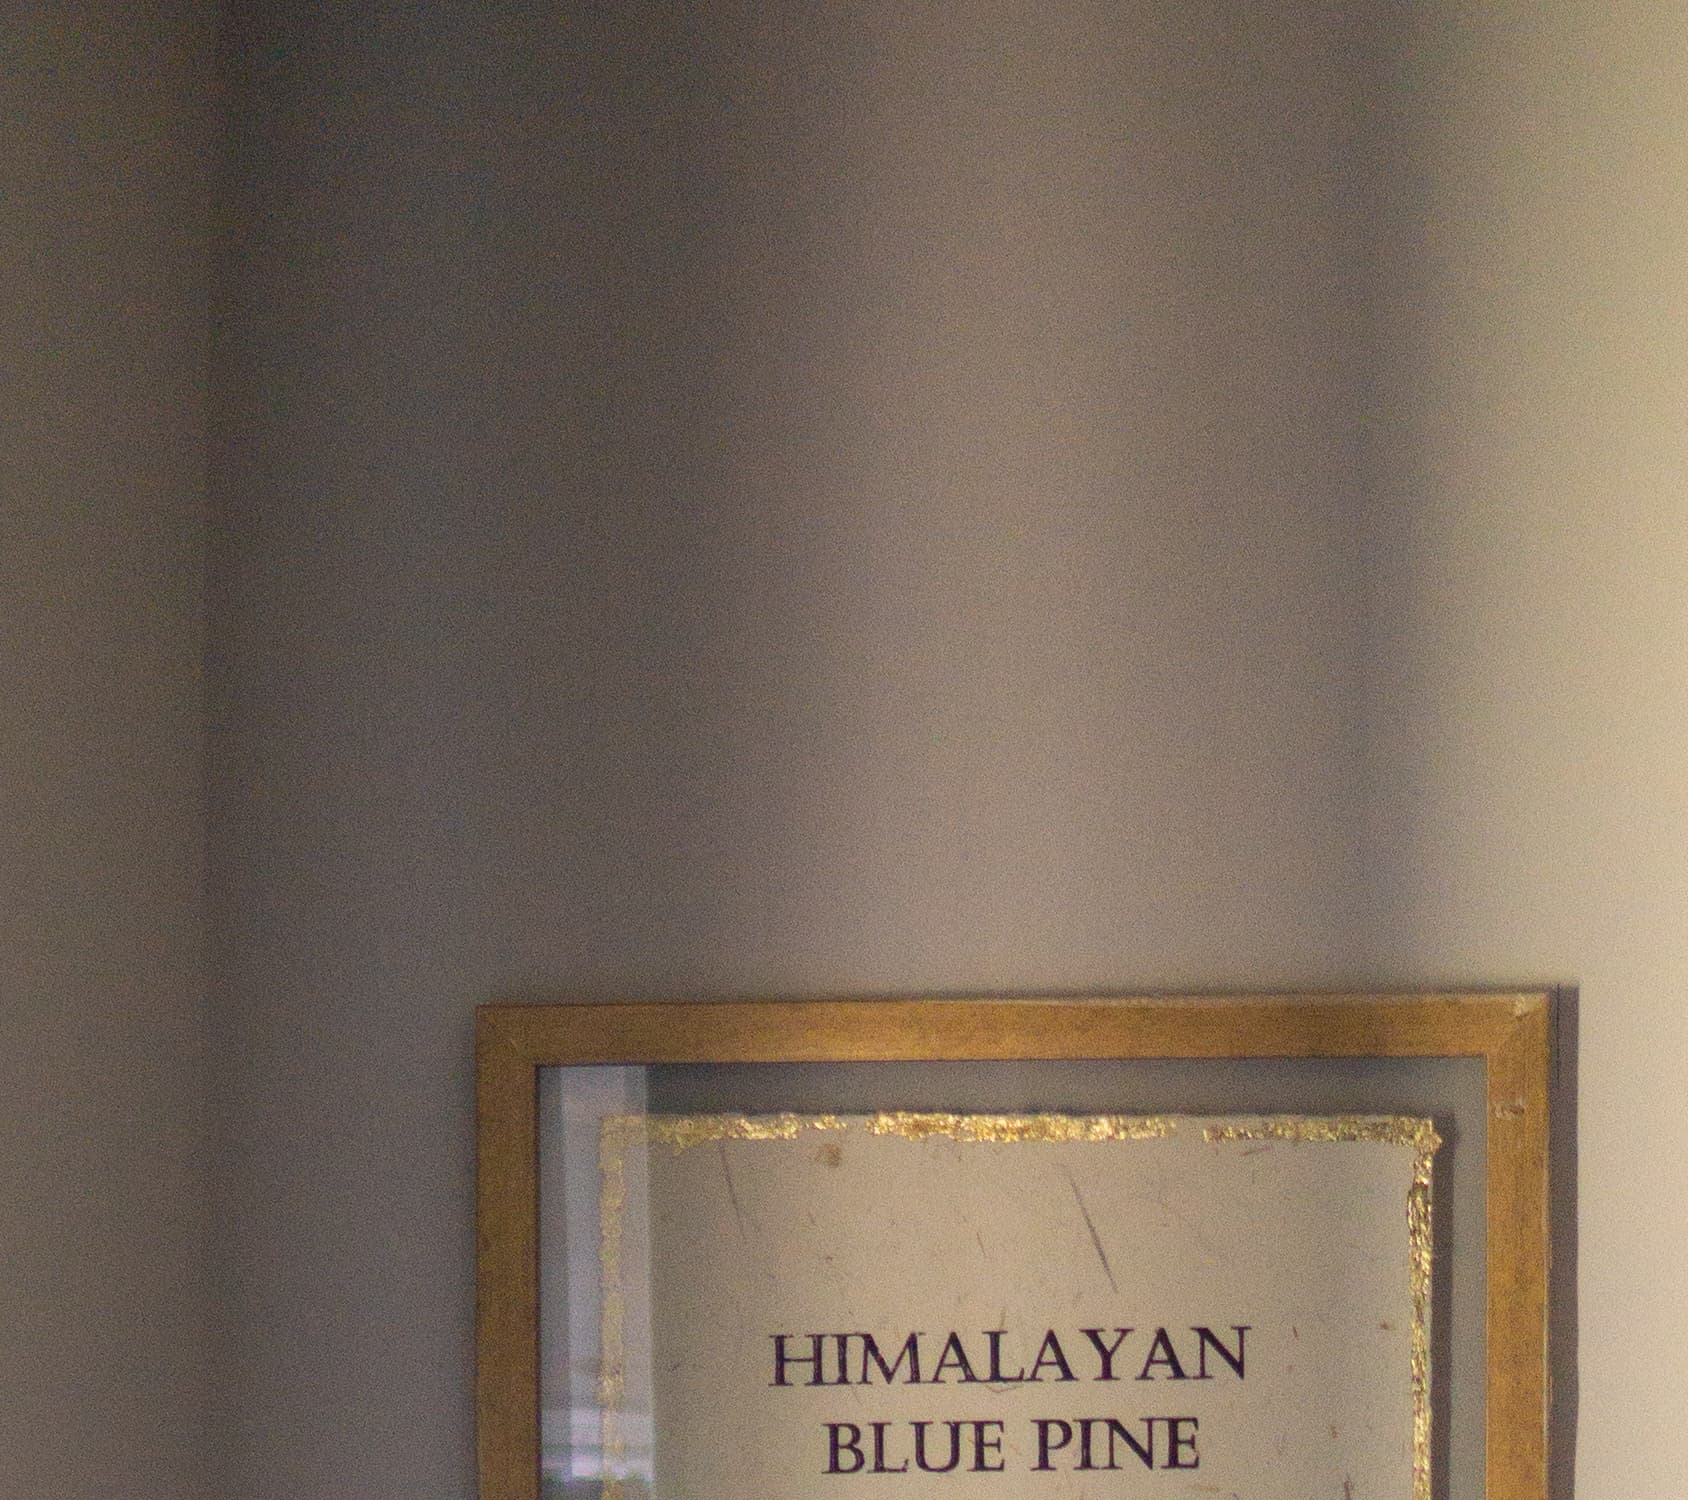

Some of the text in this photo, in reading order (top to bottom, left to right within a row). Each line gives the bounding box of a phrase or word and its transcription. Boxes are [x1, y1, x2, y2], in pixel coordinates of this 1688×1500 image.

[768, 1326, 1252, 1387] HIMALAYAN
[821, 1416, 1200, 1475] BLUE PINE
